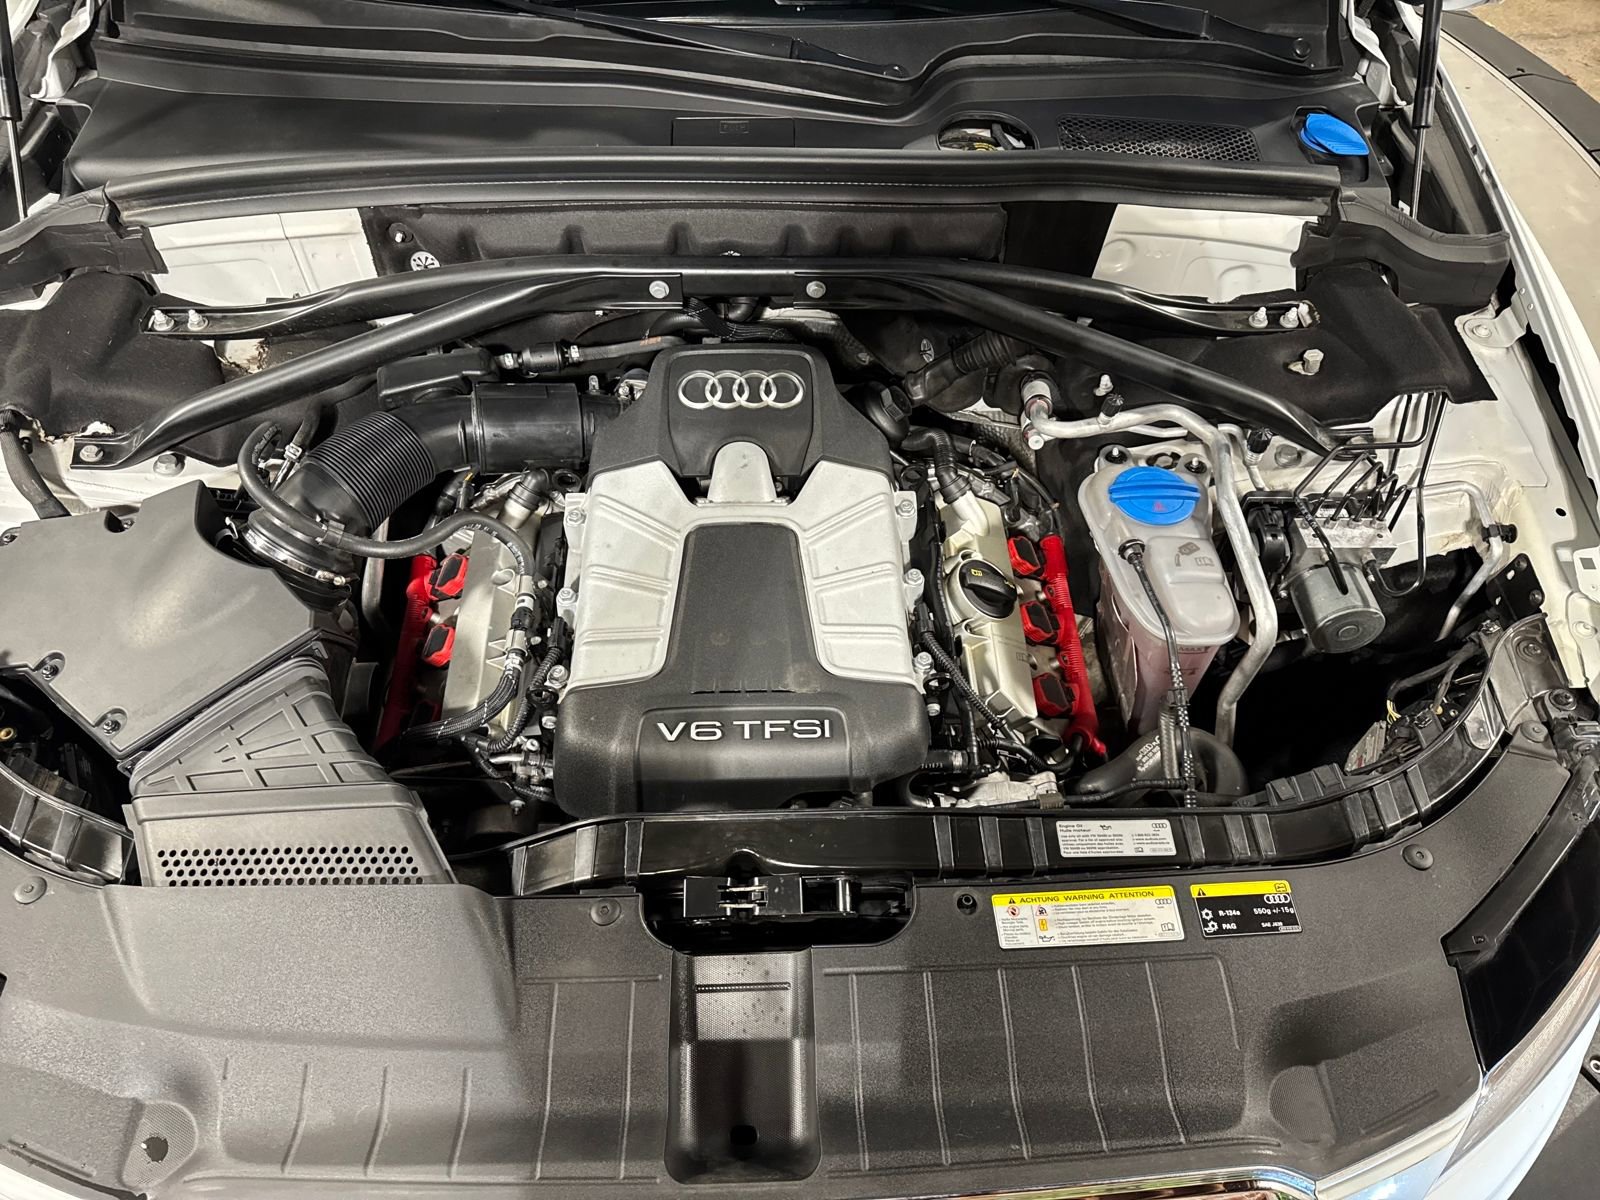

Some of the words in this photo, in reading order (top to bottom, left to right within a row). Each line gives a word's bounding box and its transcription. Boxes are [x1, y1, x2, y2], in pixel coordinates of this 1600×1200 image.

[656, 720, 723, 742] V6
[732, 719, 831, 740] TFSI
[1020, 895, 1060, 903] ACHTUNG
[1063, 893, 1105, 901] WARNING
[1108, 890, 1154, 899] ATTENTION
[1218, 909, 1241, 917] R-134a
[1253, 907, 1271, 915] 550g
